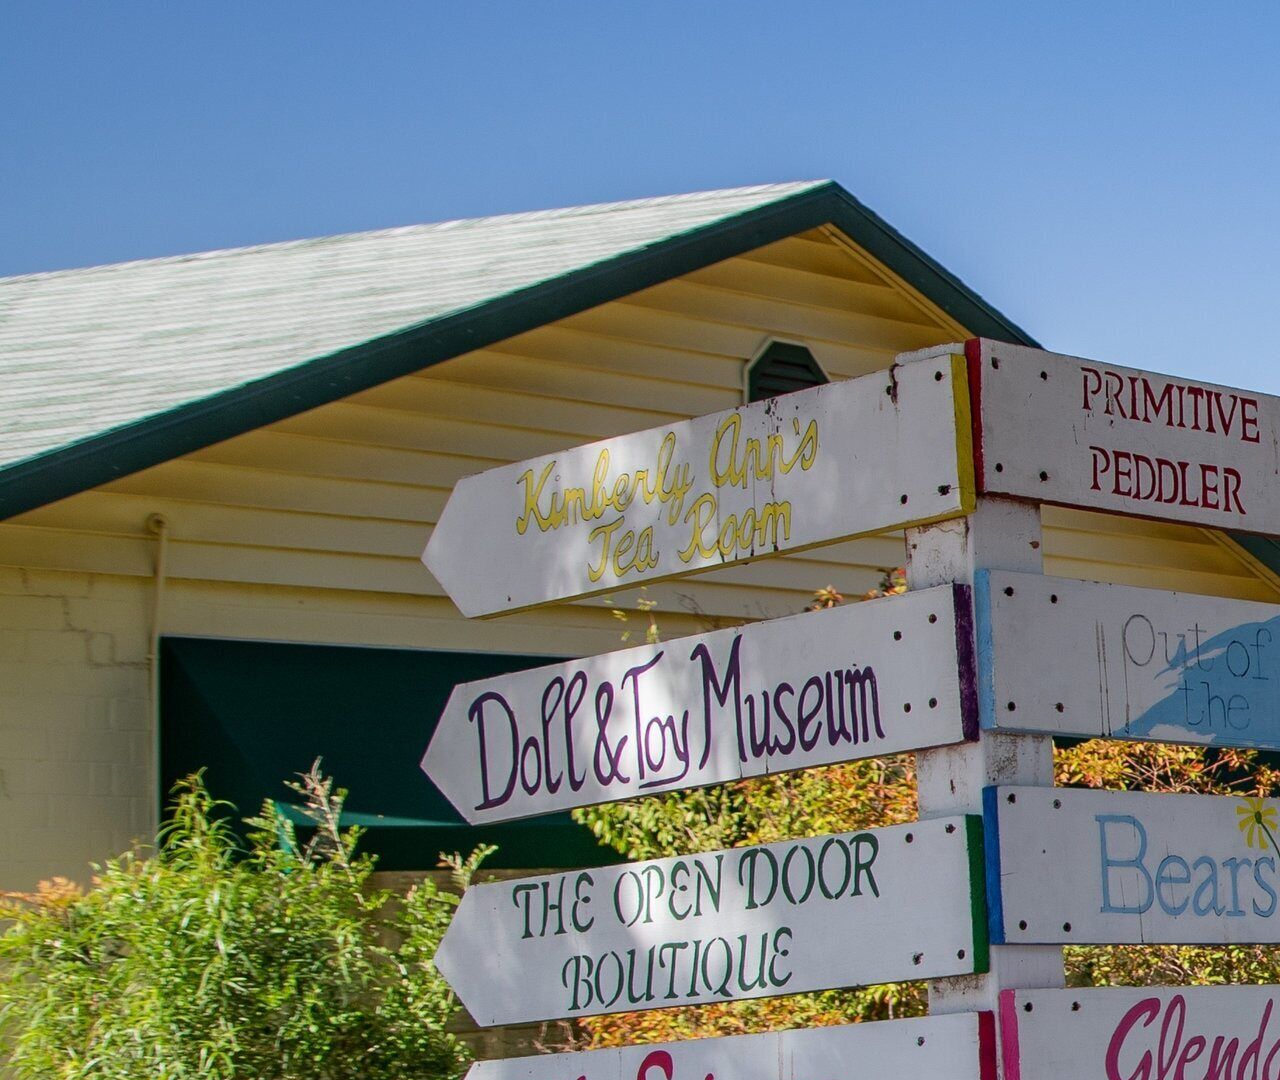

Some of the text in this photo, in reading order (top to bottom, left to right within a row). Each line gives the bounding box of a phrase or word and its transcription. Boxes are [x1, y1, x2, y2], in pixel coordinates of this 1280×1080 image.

[1081, 367, 1260, 443] PRIMITIVE
[516, 413, 818, 536] Kimberly Ann's
[1090, 446, 1246, 514] PEDDLER
[587, 493, 792, 583] Tea Room
[1122, 613, 1272, 681] Out of
[469, 635, 885, 812] Doll & Toy Museum
[1179, 679, 1251, 731] the
[513, 833, 880, 939] THE OPEN DOOR
[1095, 814, 1279, 918] Bears
[562, 927, 793, 1011] BOUTIQUE
